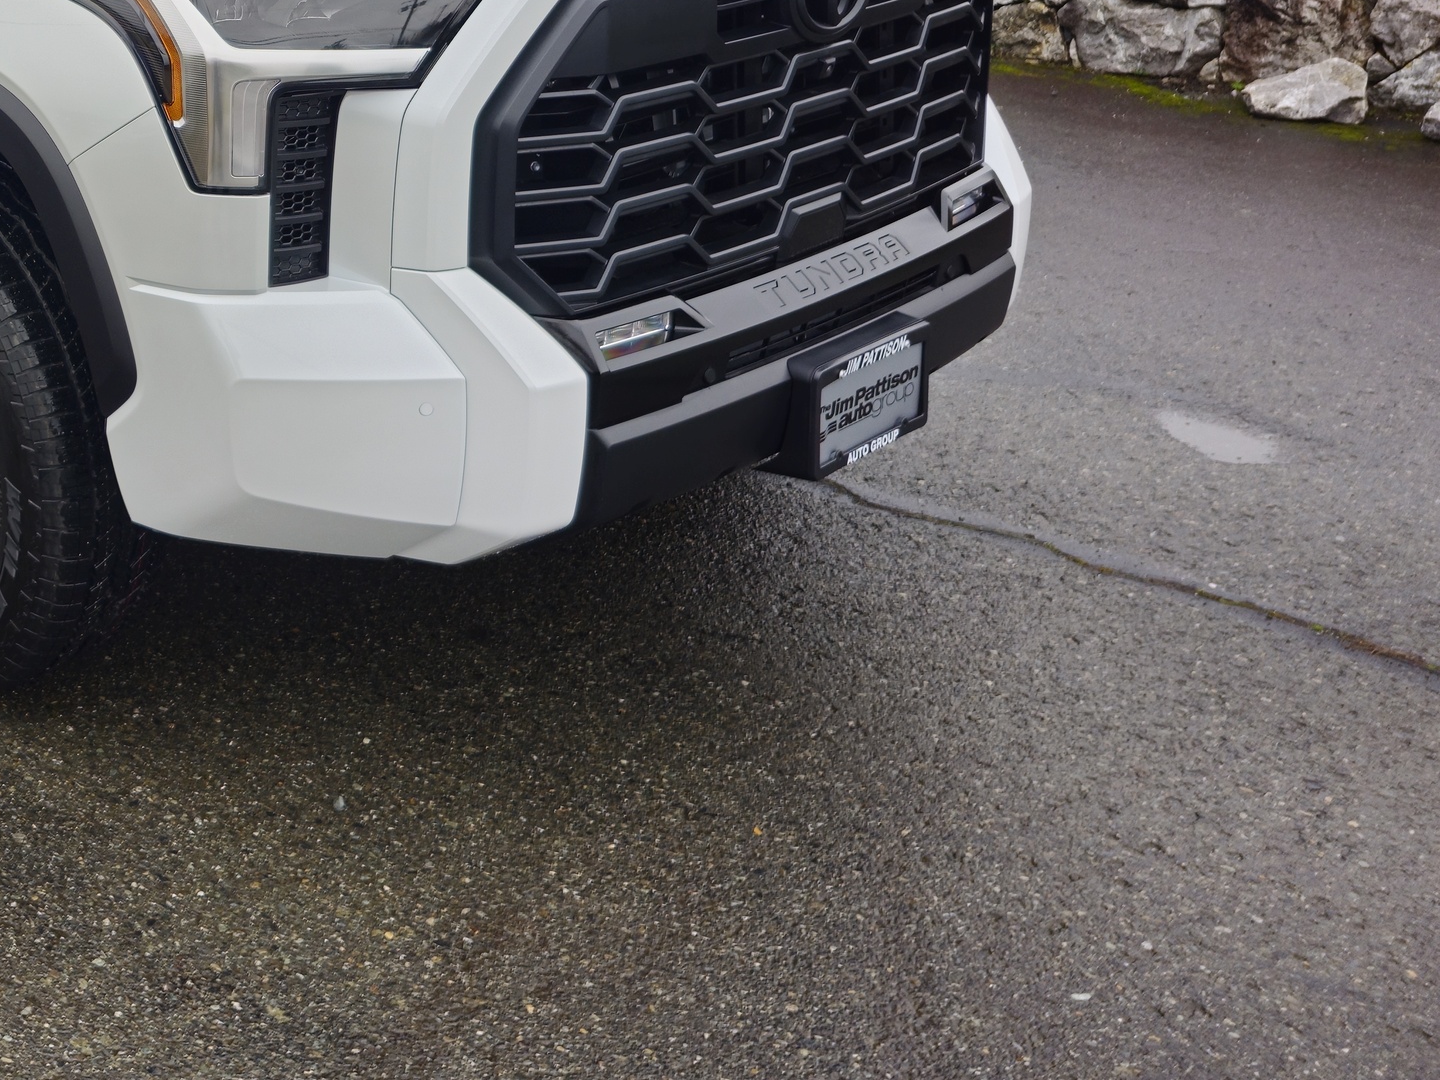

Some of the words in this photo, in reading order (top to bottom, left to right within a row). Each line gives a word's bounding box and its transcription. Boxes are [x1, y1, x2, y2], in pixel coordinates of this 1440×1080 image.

[753, 233, 911, 308] TUNDRA
[843, 355, 861, 377] JIM
[861, 334, 907, 369] PATTISON
[847, 446, 869, 466] AUTO
[870, 428, 900, 453] GROUP
